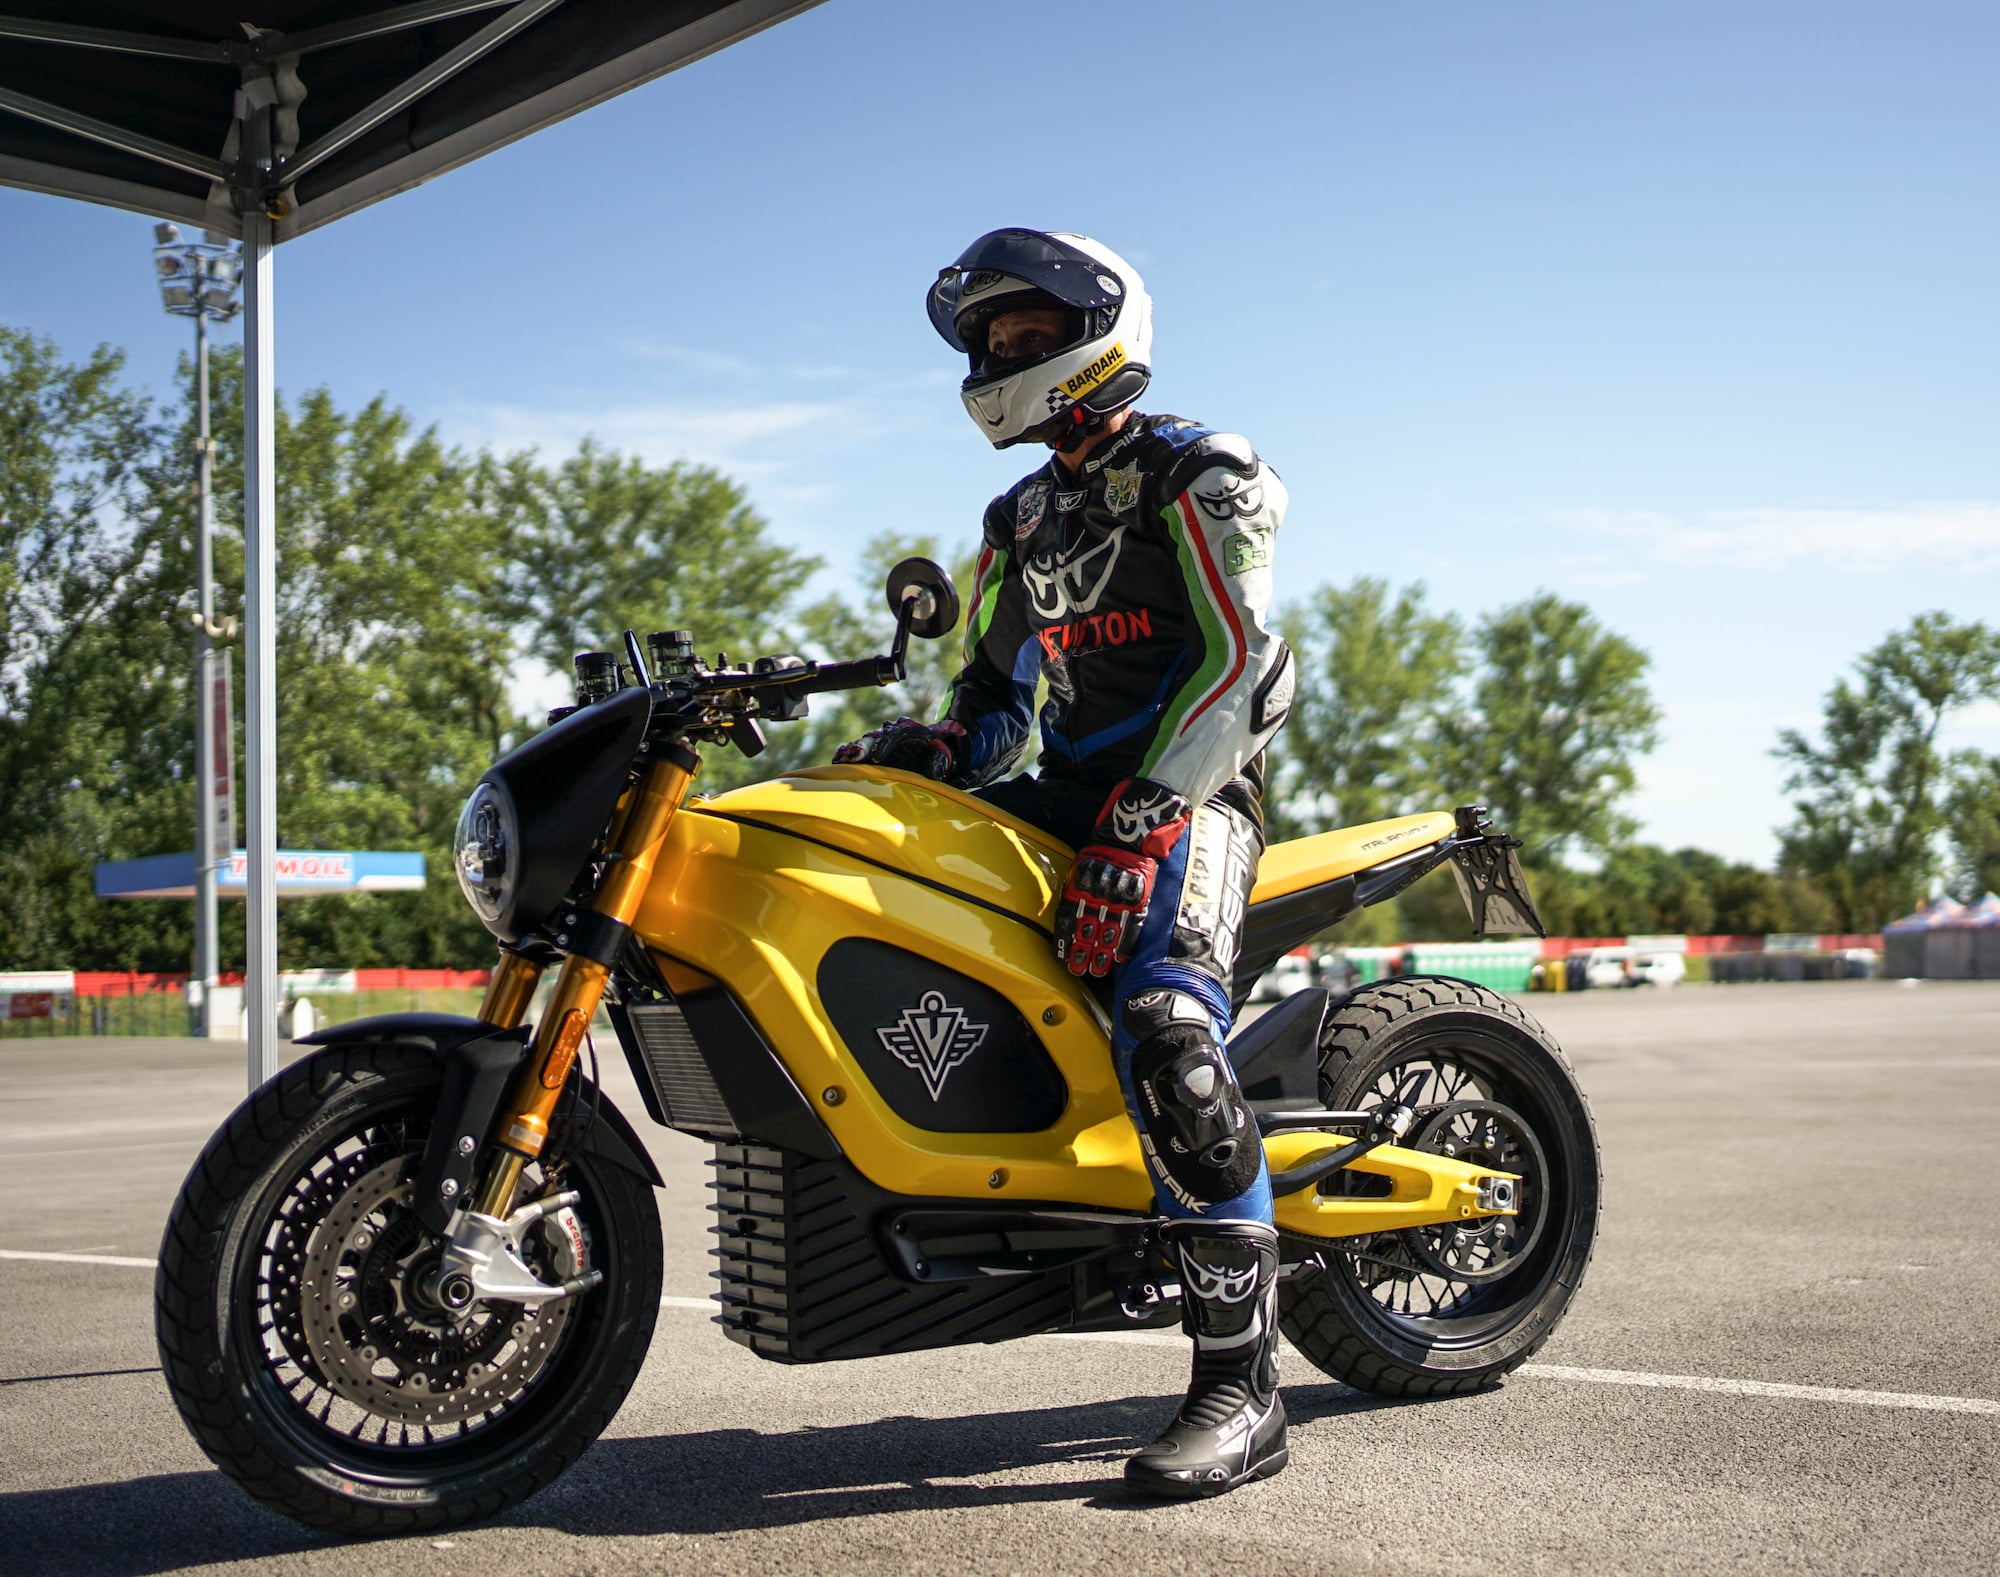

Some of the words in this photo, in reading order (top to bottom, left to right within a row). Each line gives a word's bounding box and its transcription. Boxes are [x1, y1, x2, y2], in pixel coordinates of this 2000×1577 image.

[1066, 346, 1123, 393] BARDAHL
[1085, 426, 1145, 474] BERIK
[232, 858, 347, 876] TMOIL
[1212, 807, 1254, 975] BERIK
[1142, 1079, 1161, 1118] BERIK
[1140, 1133, 1212, 1215] BERIK
[566, 1216, 584, 1267] brembo
